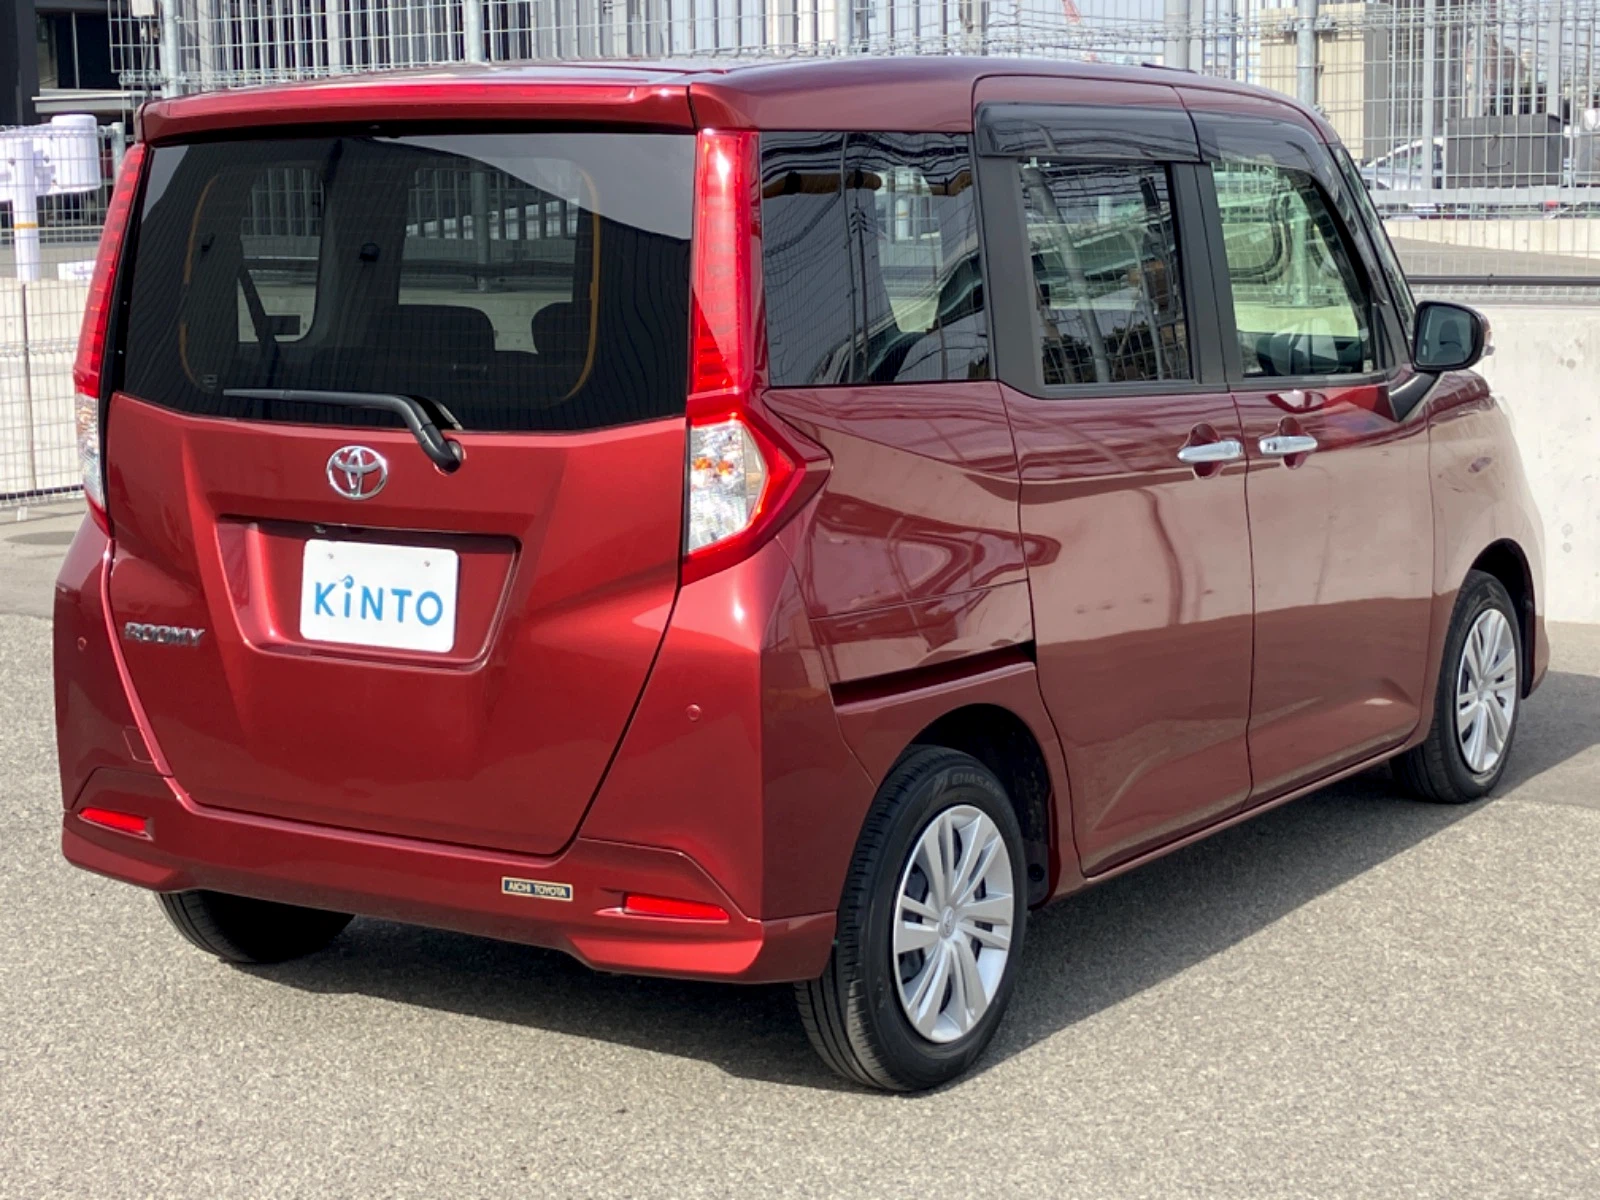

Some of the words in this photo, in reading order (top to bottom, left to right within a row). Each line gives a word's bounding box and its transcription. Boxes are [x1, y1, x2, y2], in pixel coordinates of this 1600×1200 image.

[125, 622, 205, 646] ROOMY
[507, 881, 531, 893] AICHI
[534, 885, 567, 897] TOYOTA
